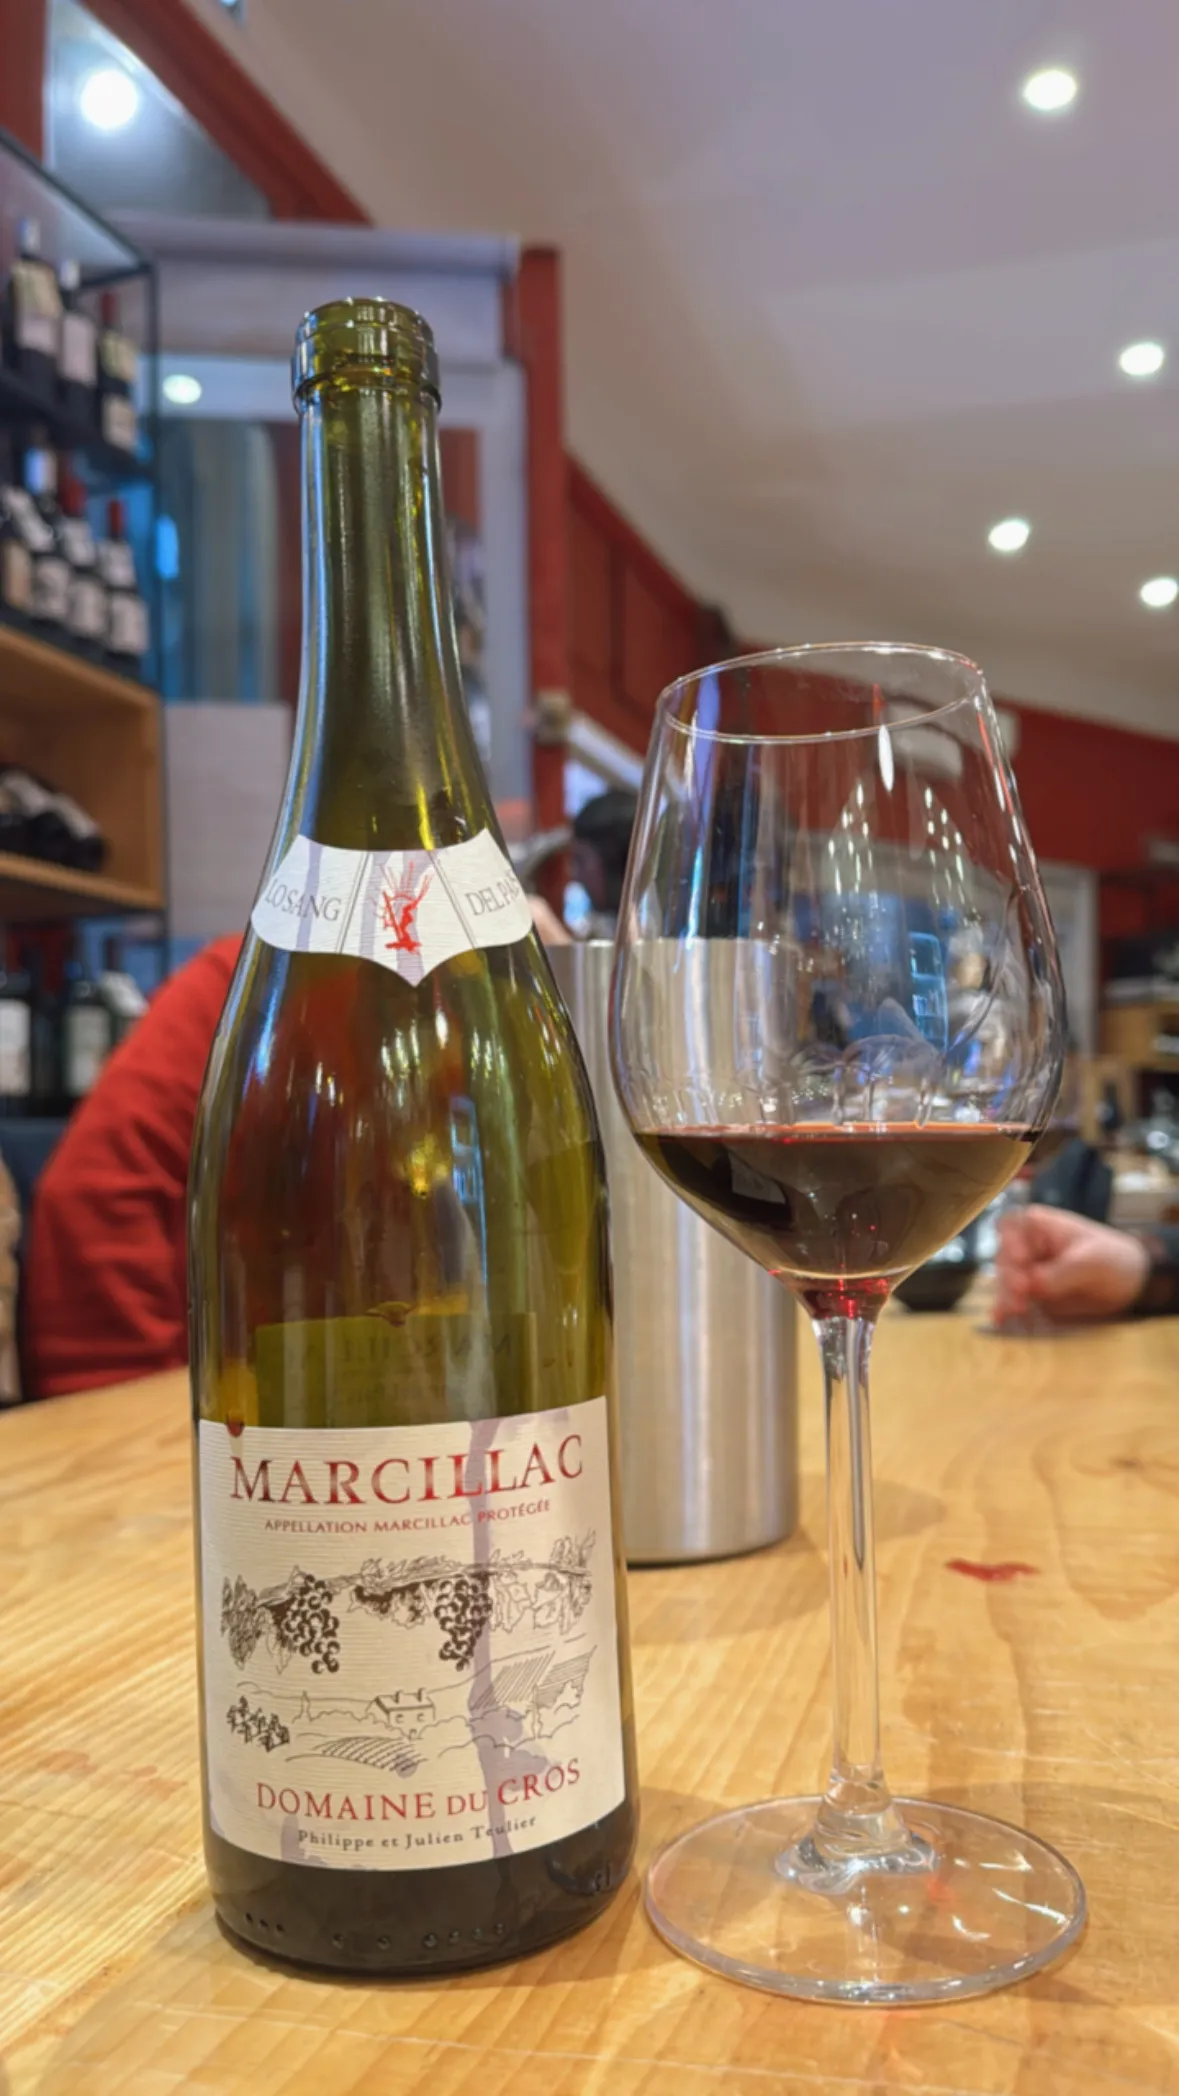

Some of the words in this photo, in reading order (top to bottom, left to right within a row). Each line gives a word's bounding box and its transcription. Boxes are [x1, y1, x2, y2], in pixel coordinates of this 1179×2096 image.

[229, 1434, 583, 1506] MARCILLAC
[264, 1519, 367, 1534] APPELLATION
[373, 1511, 471, 1532] MARCILLAC
[477, 1498, 551, 1524] PROTÉGÉE
[256, 1782, 436, 1821] DOMAINE
[447, 1790, 489, 1816] DU
[496, 1758, 581, 1806] CROS
[298, 1829, 374, 1852] Philippe
[381, 1836, 399, 1848] et
[404, 1832, 464, 1849] Julien
[469, 1816, 537, 1840] Teulier
